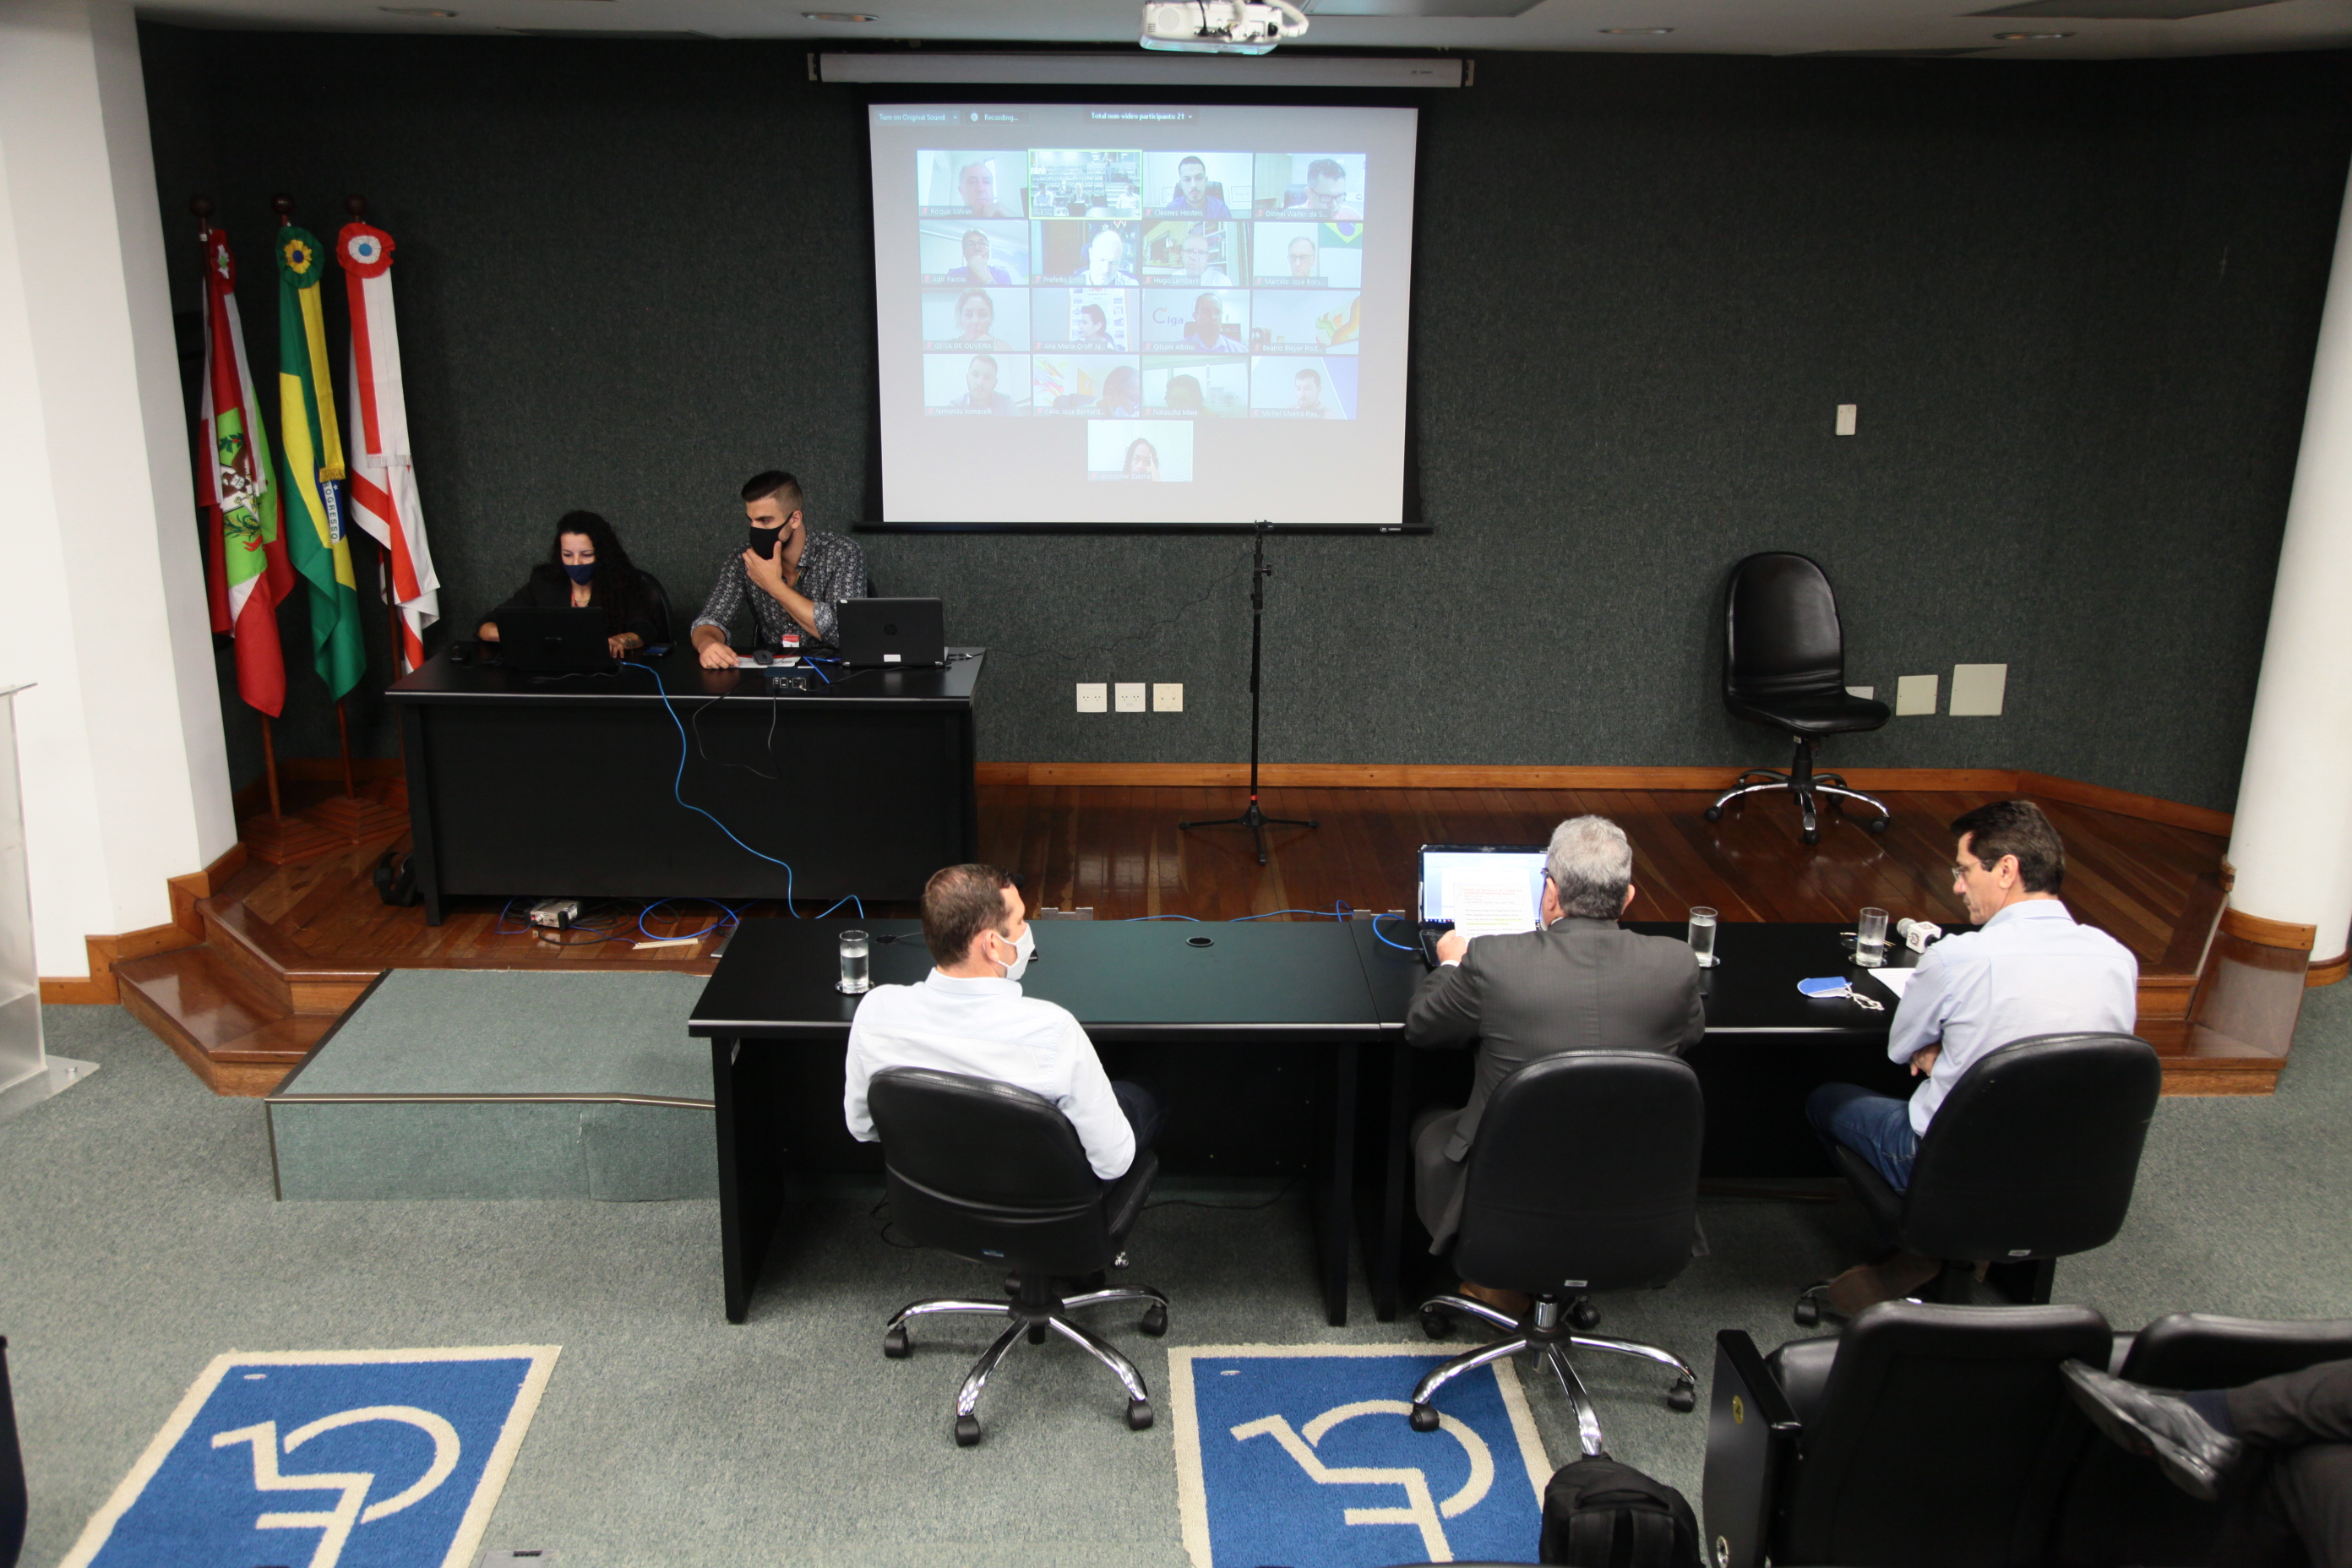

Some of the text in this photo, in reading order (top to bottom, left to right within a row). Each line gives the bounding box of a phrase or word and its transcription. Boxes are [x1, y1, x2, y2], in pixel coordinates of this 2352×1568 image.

[902, 113, 926, 122] Original
[1140, 113, 1176, 122] participants:
[1153, 277, 1171, 286] Hugo
[1152, 308, 1184, 326] Ciga
[323, 481, 338, 539] ROGRESSO
